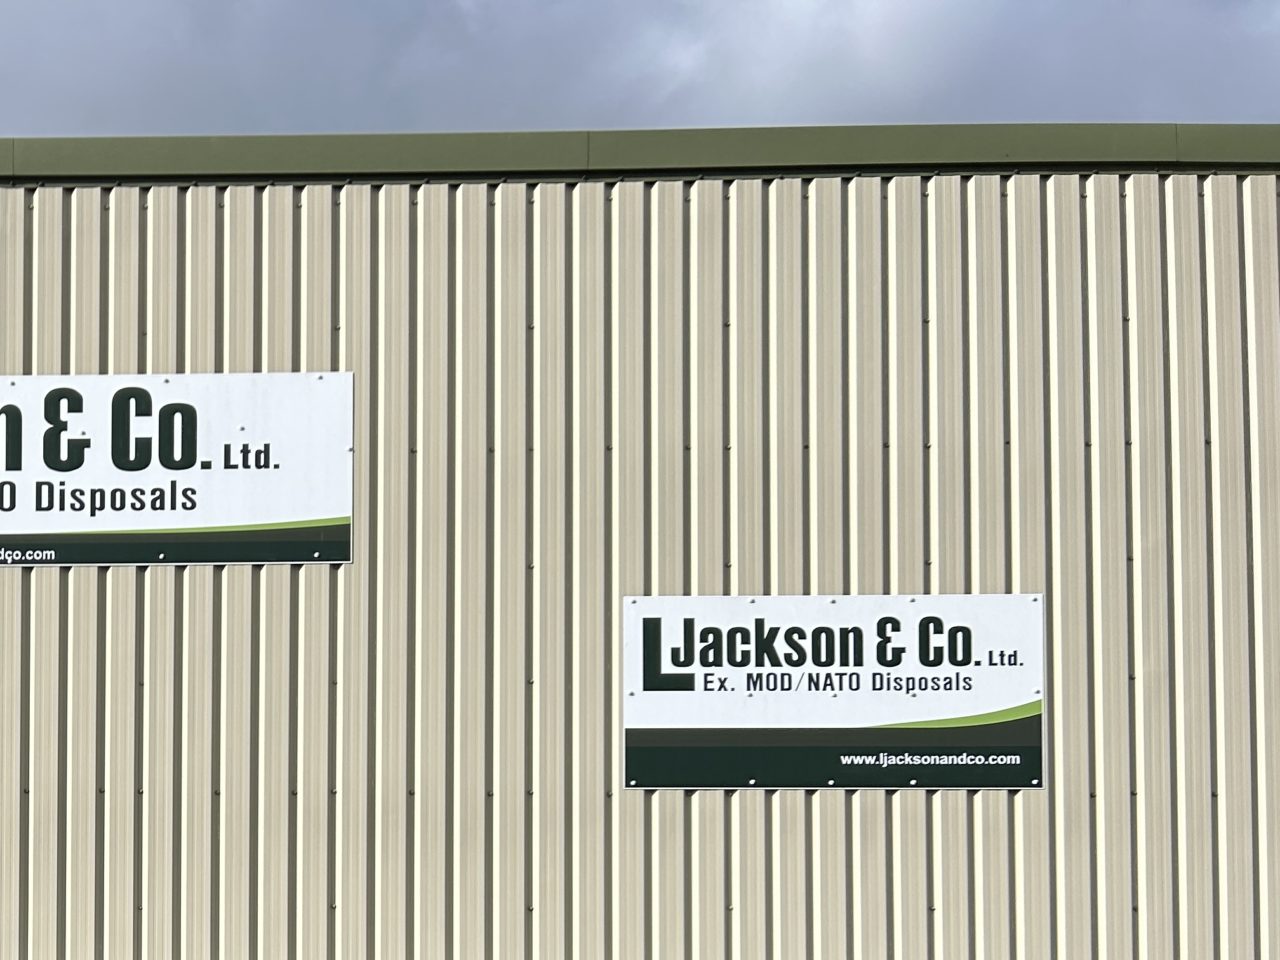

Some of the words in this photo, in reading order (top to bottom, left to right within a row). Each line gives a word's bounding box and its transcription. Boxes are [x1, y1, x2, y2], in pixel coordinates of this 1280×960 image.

[42, 387, 91, 472] &
[111, 386, 212, 471] Co.
[224, 443, 280, 470] Ltd.
[35, 479, 197, 517] Disposals
[876, 616, 906, 668] &
[918, 616, 982, 668] Co.
[988, 650, 1024, 667] Ltd.
[703, 672, 735, 692] Ex.
[746, 671, 861, 692] MOD/NATO
[872, 671, 972, 694] Disposals
[840, 752, 1021, 767] www.ljacksonandco.com
